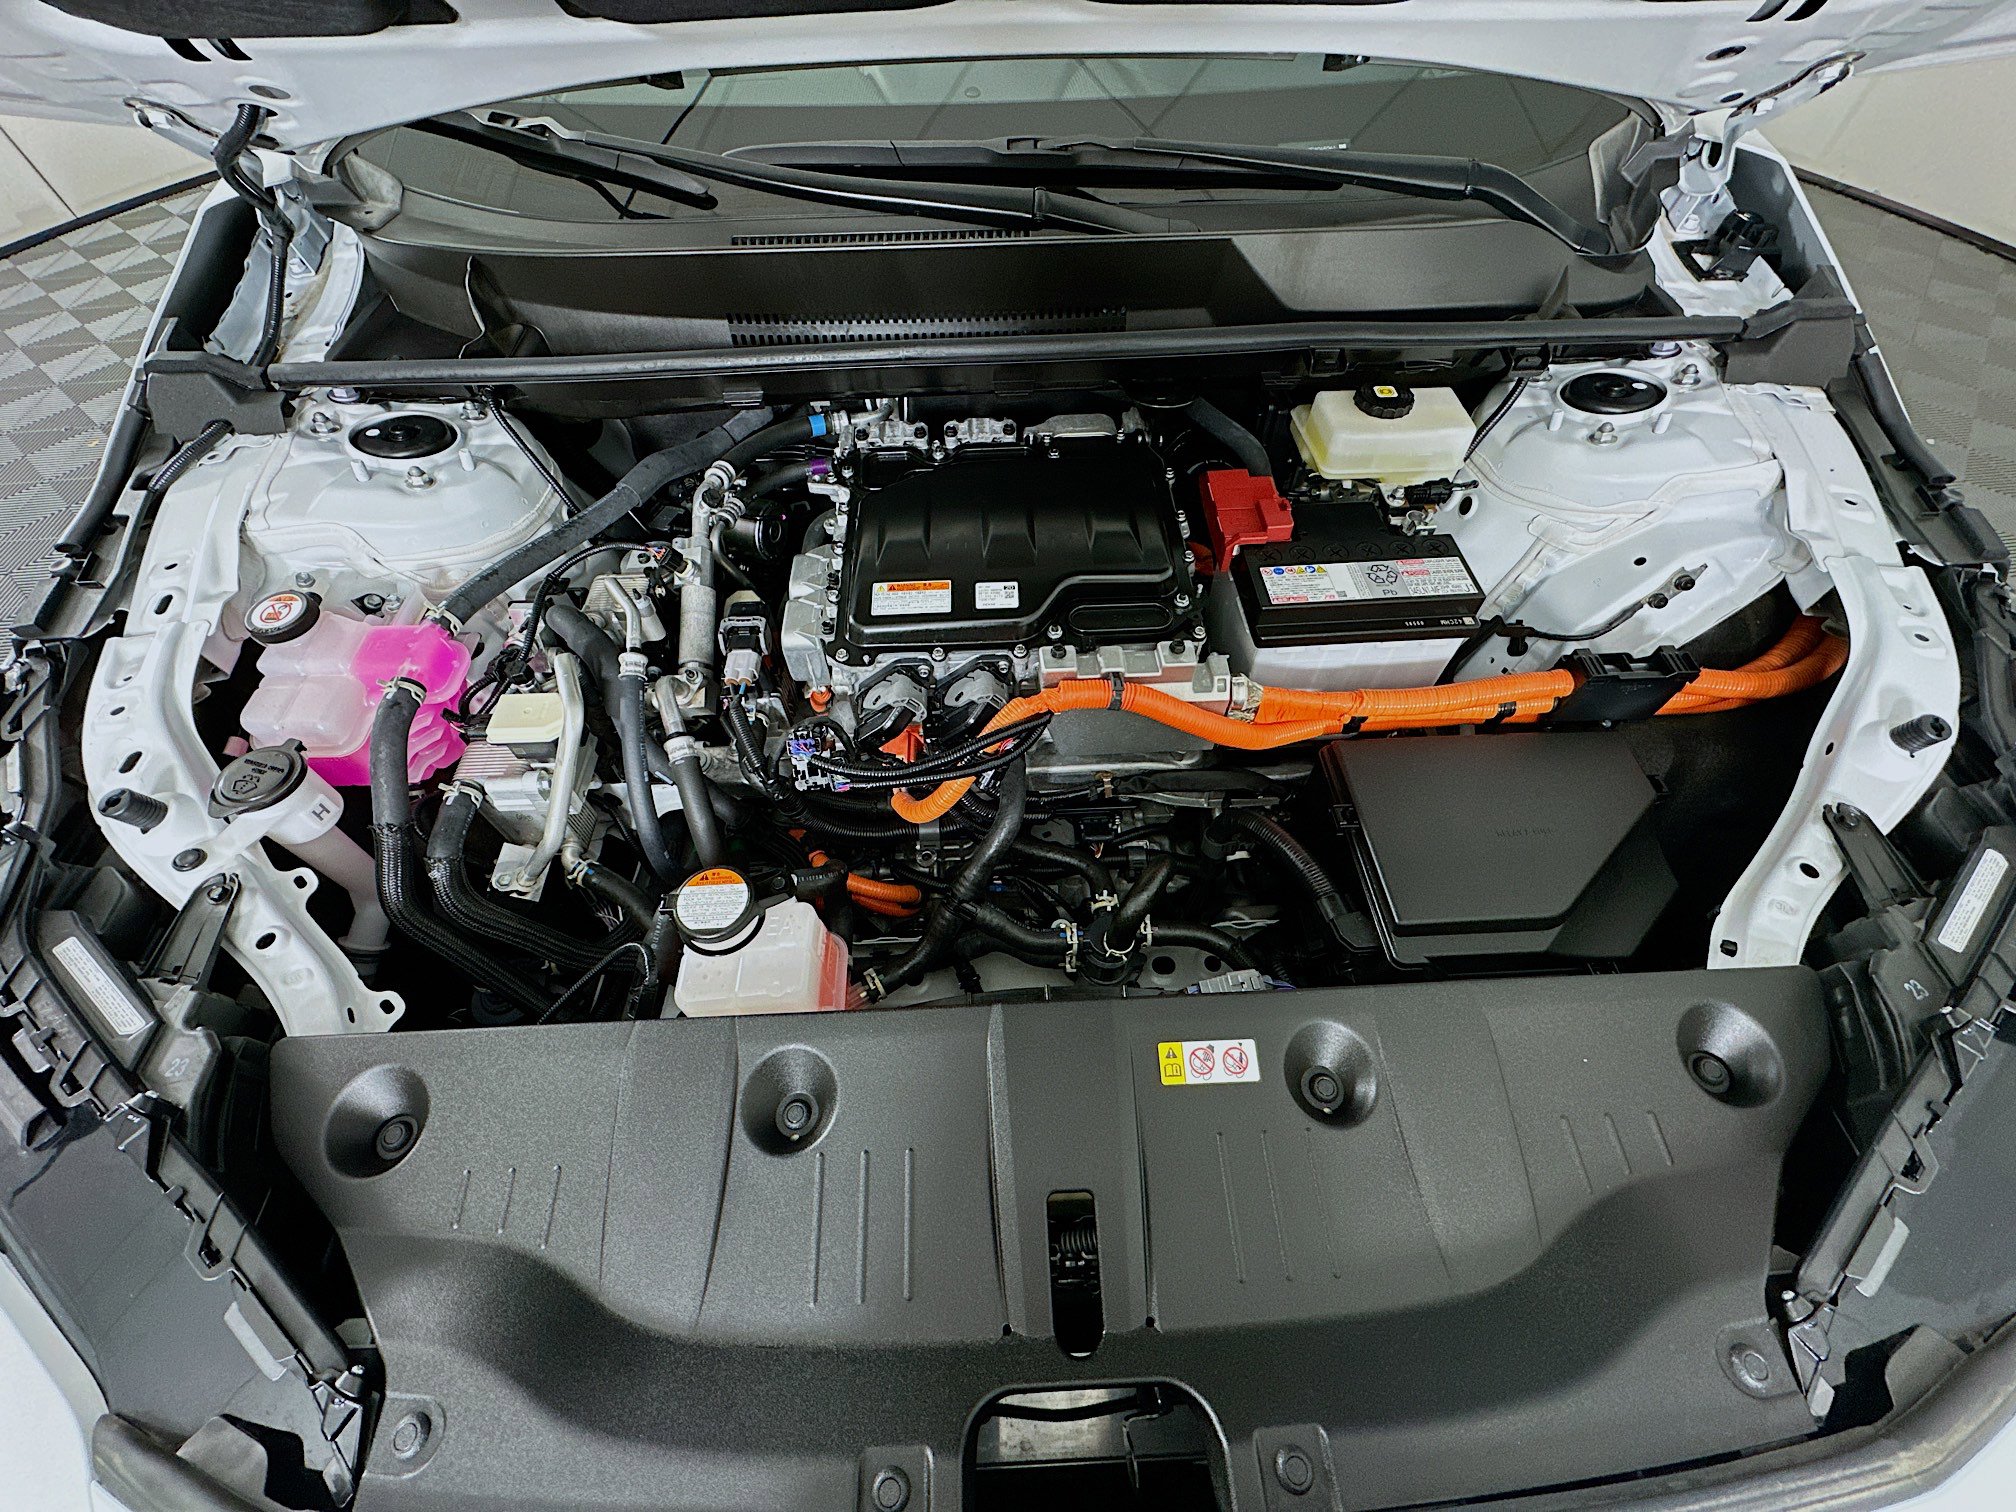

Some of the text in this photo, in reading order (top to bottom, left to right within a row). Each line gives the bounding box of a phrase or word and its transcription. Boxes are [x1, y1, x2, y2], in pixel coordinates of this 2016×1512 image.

[311, 802, 331, 822] H
[1903, 979, 1930, 1001] 23
[164, 1058, 190, 1077] 23
